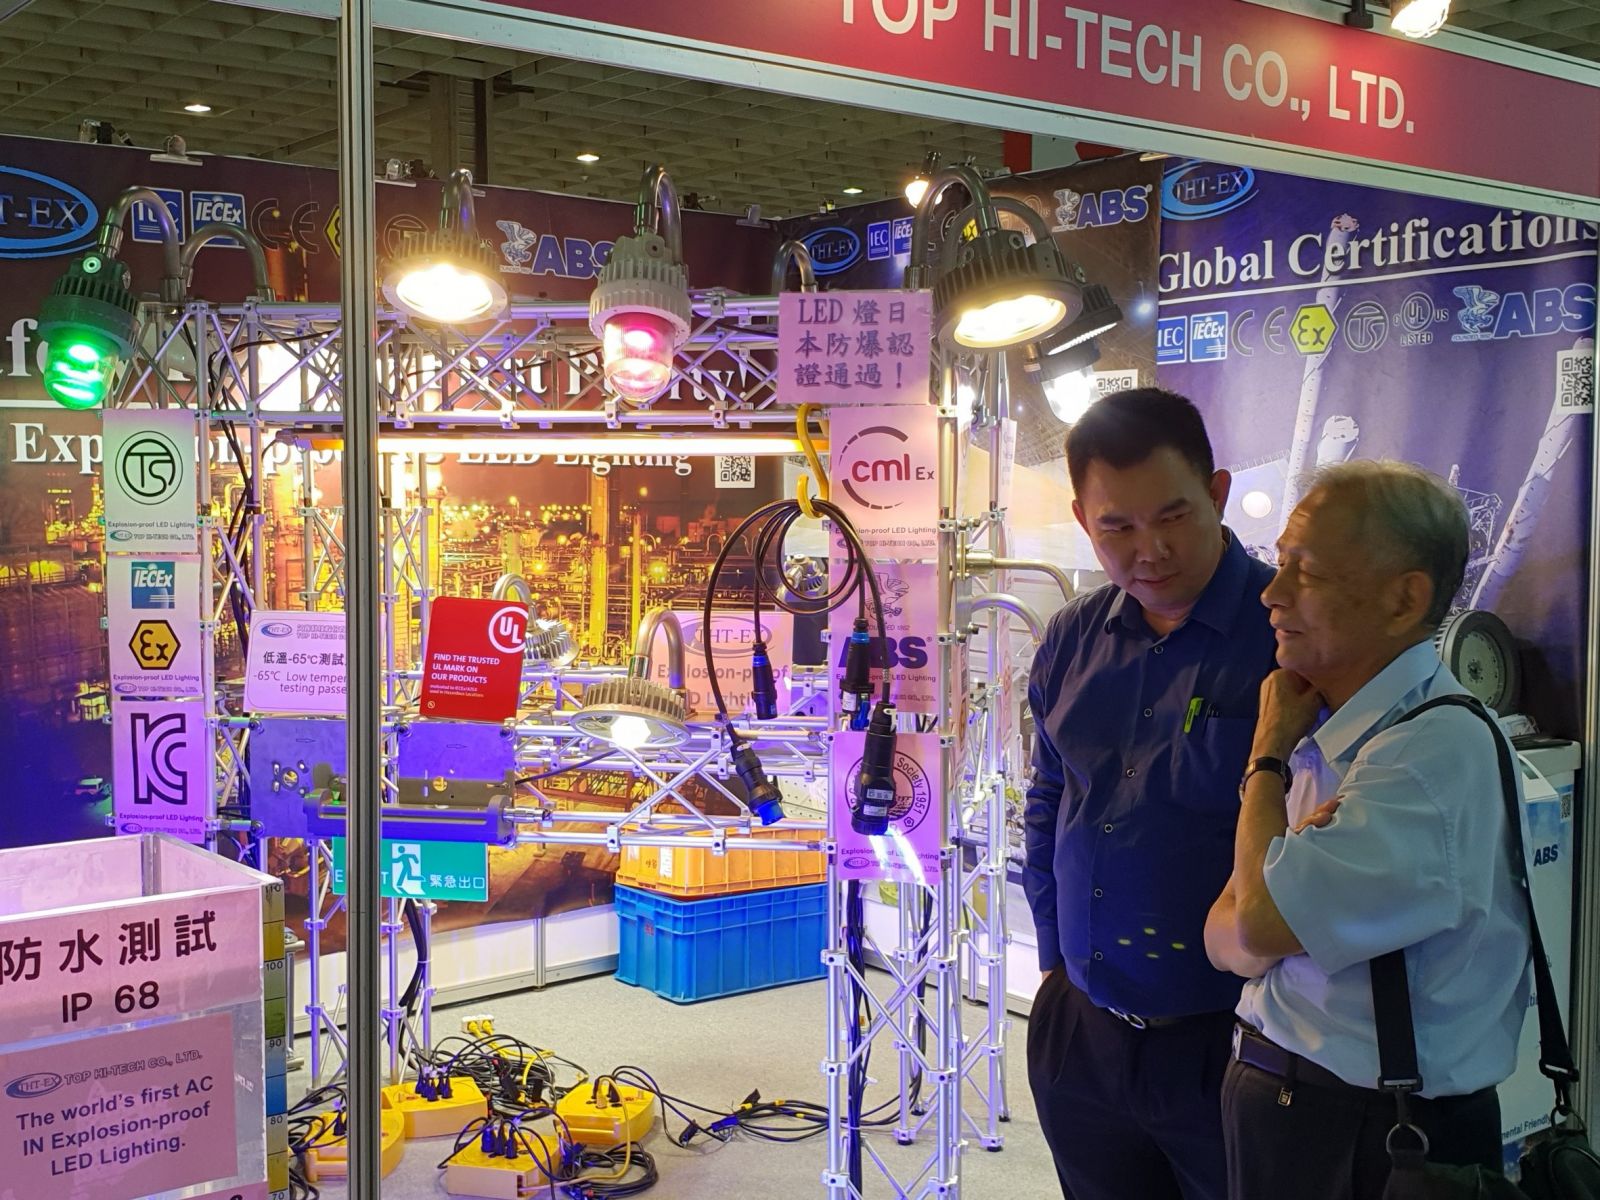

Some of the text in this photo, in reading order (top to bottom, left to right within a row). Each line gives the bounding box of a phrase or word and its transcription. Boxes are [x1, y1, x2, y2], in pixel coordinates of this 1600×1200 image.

[985, 0, 1202, 92] HI-TECH
[1222, 43, 1311, 122] CO.,
[1329, 65, 1415, 134] LTD.
[195, 202, 242, 223] IECEx
[1076, 184, 1150, 230] ABS
[870, 229, 889, 249] IEC
[894, 223, 913, 240] IECE
[1157, 207, 1598, 293] Global Certifications
[798, 298, 843, 325] LED
[1493, 284, 1597, 340] ABS
[1158, 327, 1184, 349] IEC
[1193, 320, 1225, 341] IECEx
[1400, 332, 1433, 347] LISTED
[795, 330, 914, 360] 本防爆認
[851, 453, 935, 483] cml Ex
[908, 527, 937, 535] Lighting
[134, 569, 173, 588] IECEx
[499, 616, 523, 645] UL
[139, 629, 169, 661] Ex
[838, 636, 929, 670] BS
[432, 663, 441, 671] UL
[466, 666, 478, 674] ON
[433, 653, 500, 666] FIND THE TRUSTED
[286, 671, 308, 682] Low
[431, 673, 488, 684] OUR PRODUCTS
[908, 675, 937, 683] Lighting
[280, 683, 348, 696] testing passe
[896, 756, 928, 816] Society 1951
[1533, 843, 1559, 867] ABS
[429, 873, 485, 889] 緊急出口
[0, 910, 218, 986] 防水測試
[266, 960, 284, 972] 100
[61, 980, 160, 1024] IP 68
[269, 1038, 283, 1048] 90
[63, 1070, 91, 1086] TOP
[93, 1060, 145, 1080] HI-TECH
[15, 1111, 55, 1132] The
[141, 1083, 180, 1105] first
[185, 1075, 214, 1096] AC
[22, 1100, 212, 1157] IN Explosion-proof
[270, 1115, 284, 1126] 80
[50, 1136, 187, 1177] LED Lighting.
